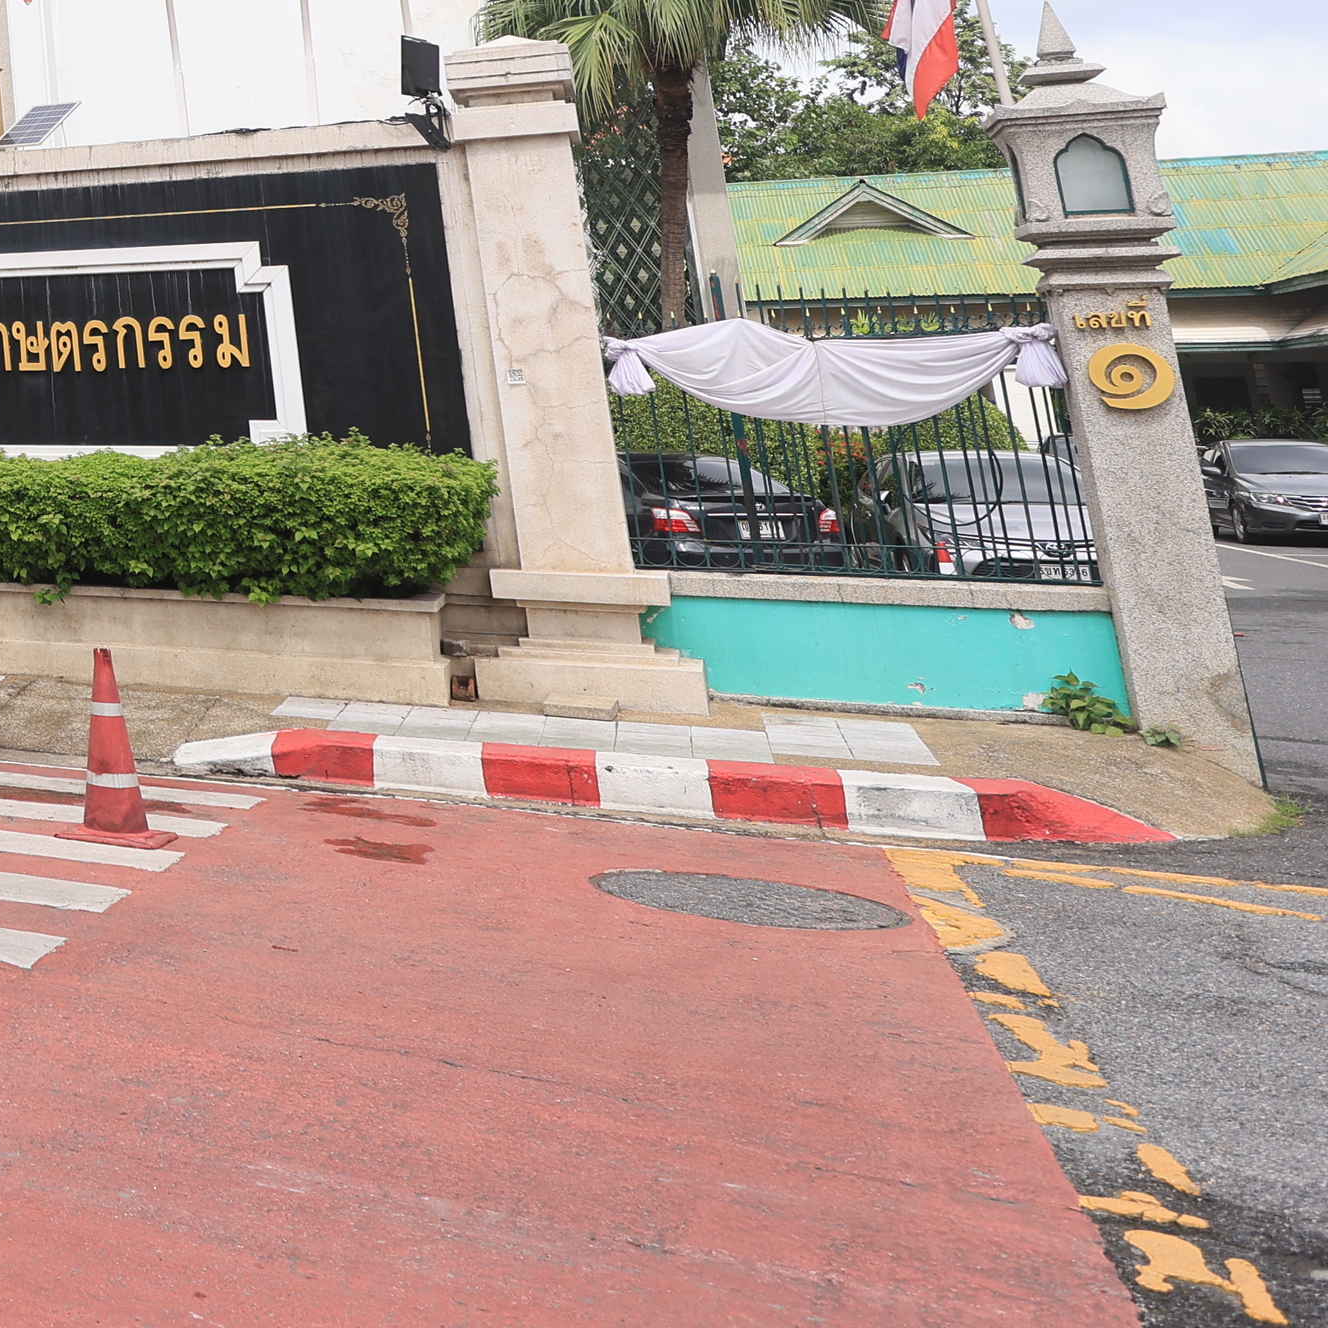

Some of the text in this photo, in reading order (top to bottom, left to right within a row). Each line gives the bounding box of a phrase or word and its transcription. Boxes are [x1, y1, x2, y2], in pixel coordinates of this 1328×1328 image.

[1072, 294, 1153, 329] เลขที่
[1089, 342, 1176, 410] ๑
